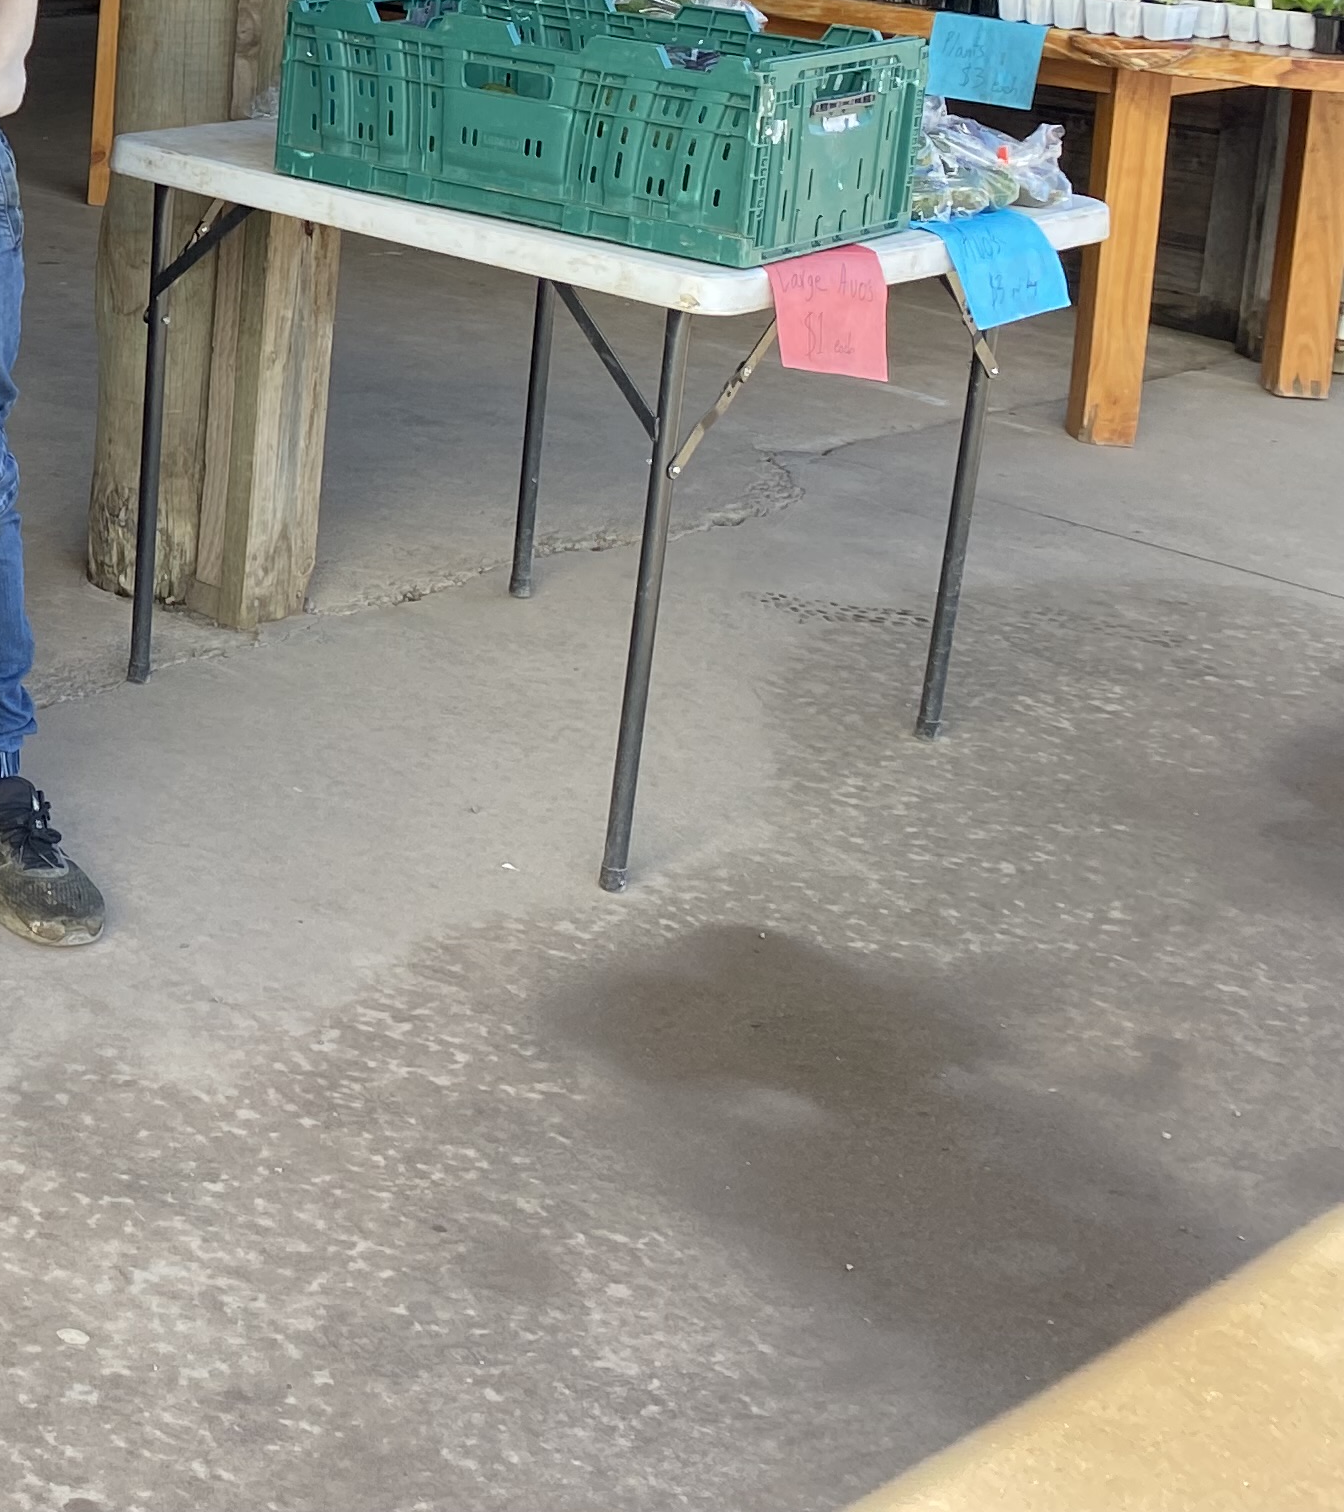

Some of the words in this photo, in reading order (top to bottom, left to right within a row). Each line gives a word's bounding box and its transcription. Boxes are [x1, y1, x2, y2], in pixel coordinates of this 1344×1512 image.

[775, 267, 828, 302] Large
[838, 261, 875, 303] Avos
[803, 311, 825, 362] $1
